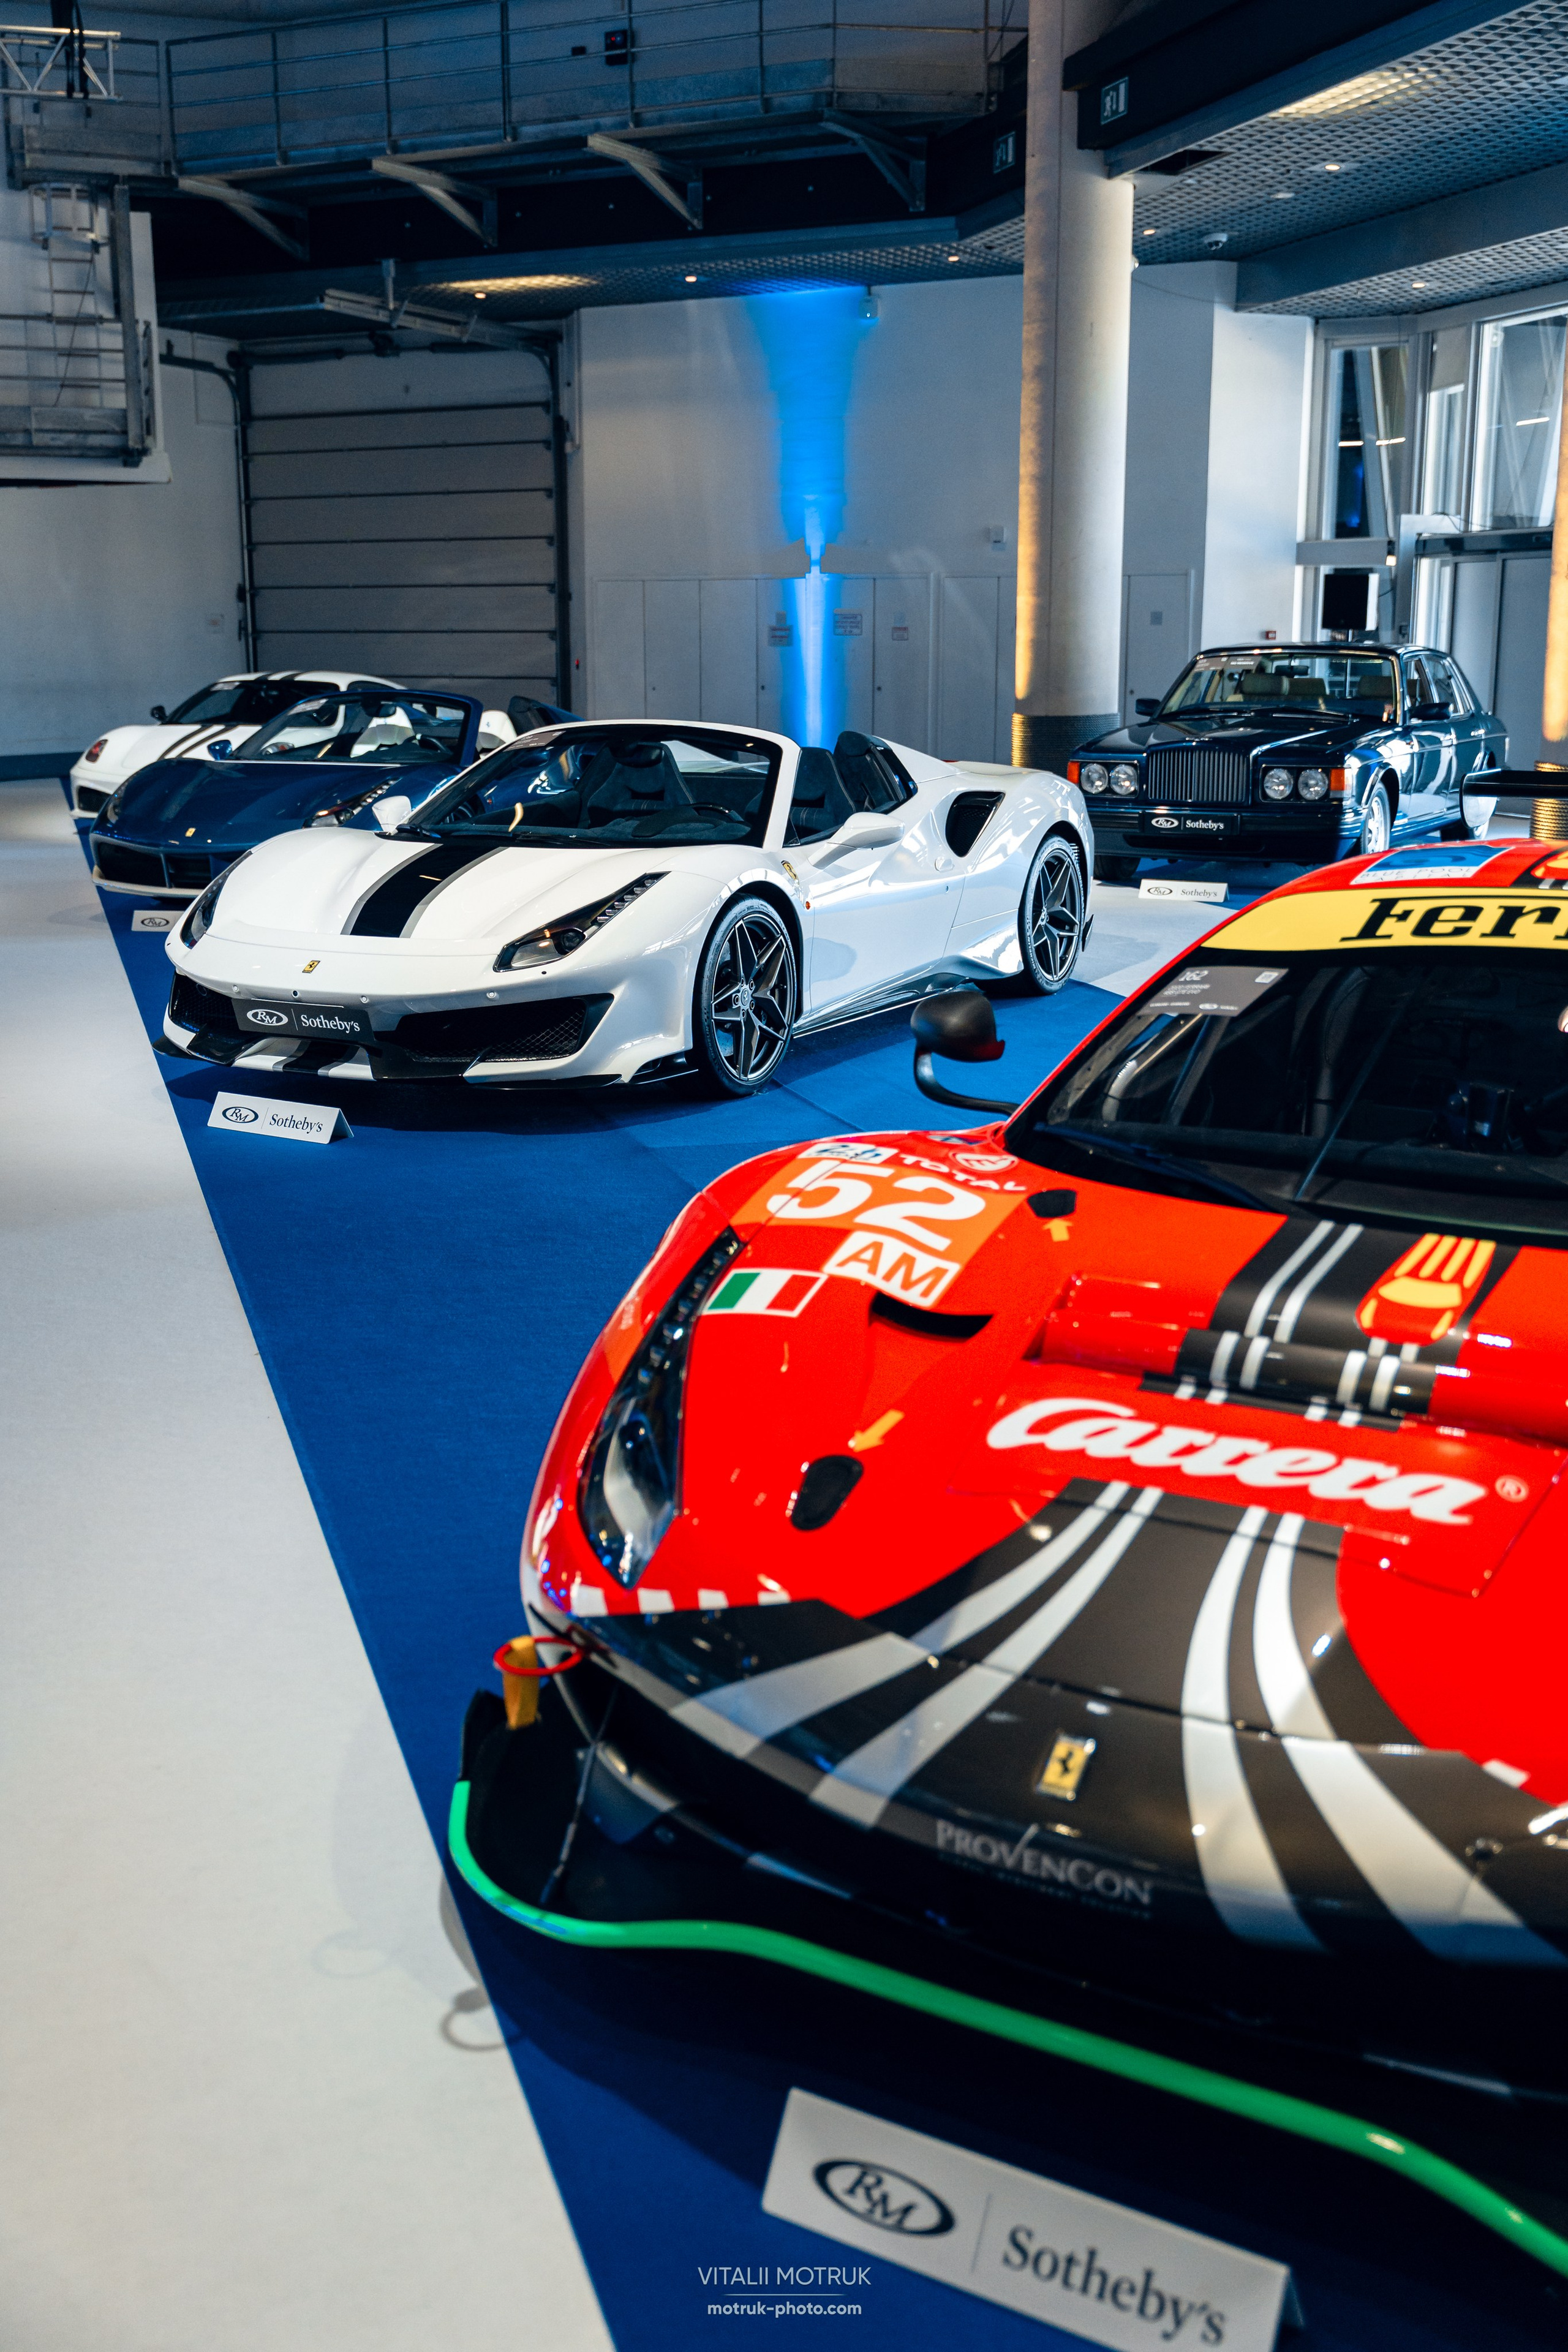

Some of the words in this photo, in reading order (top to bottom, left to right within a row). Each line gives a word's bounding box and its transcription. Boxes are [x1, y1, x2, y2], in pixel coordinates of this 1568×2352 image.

[1185, 819, 1224, 831] Sotheby's
[1360, 870, 1405, 878] BLUE
[1180, 889, 1218, 899] Sotheby's
[1339, 895, 1568, 942] Fer
[300, 1014, 361, 1034] Sotheby's
[269, 1113, 323, 1134] Sotheby's
[899, 1153, 1027, 1191] TOTAL
[766, 1159, 986, 1252] 52
[835, 1240, 950, 1299] AM
[986, 1397, 1488, 1525] Carrera
[1001, 2223, 1227, 2347] Sotheby's
